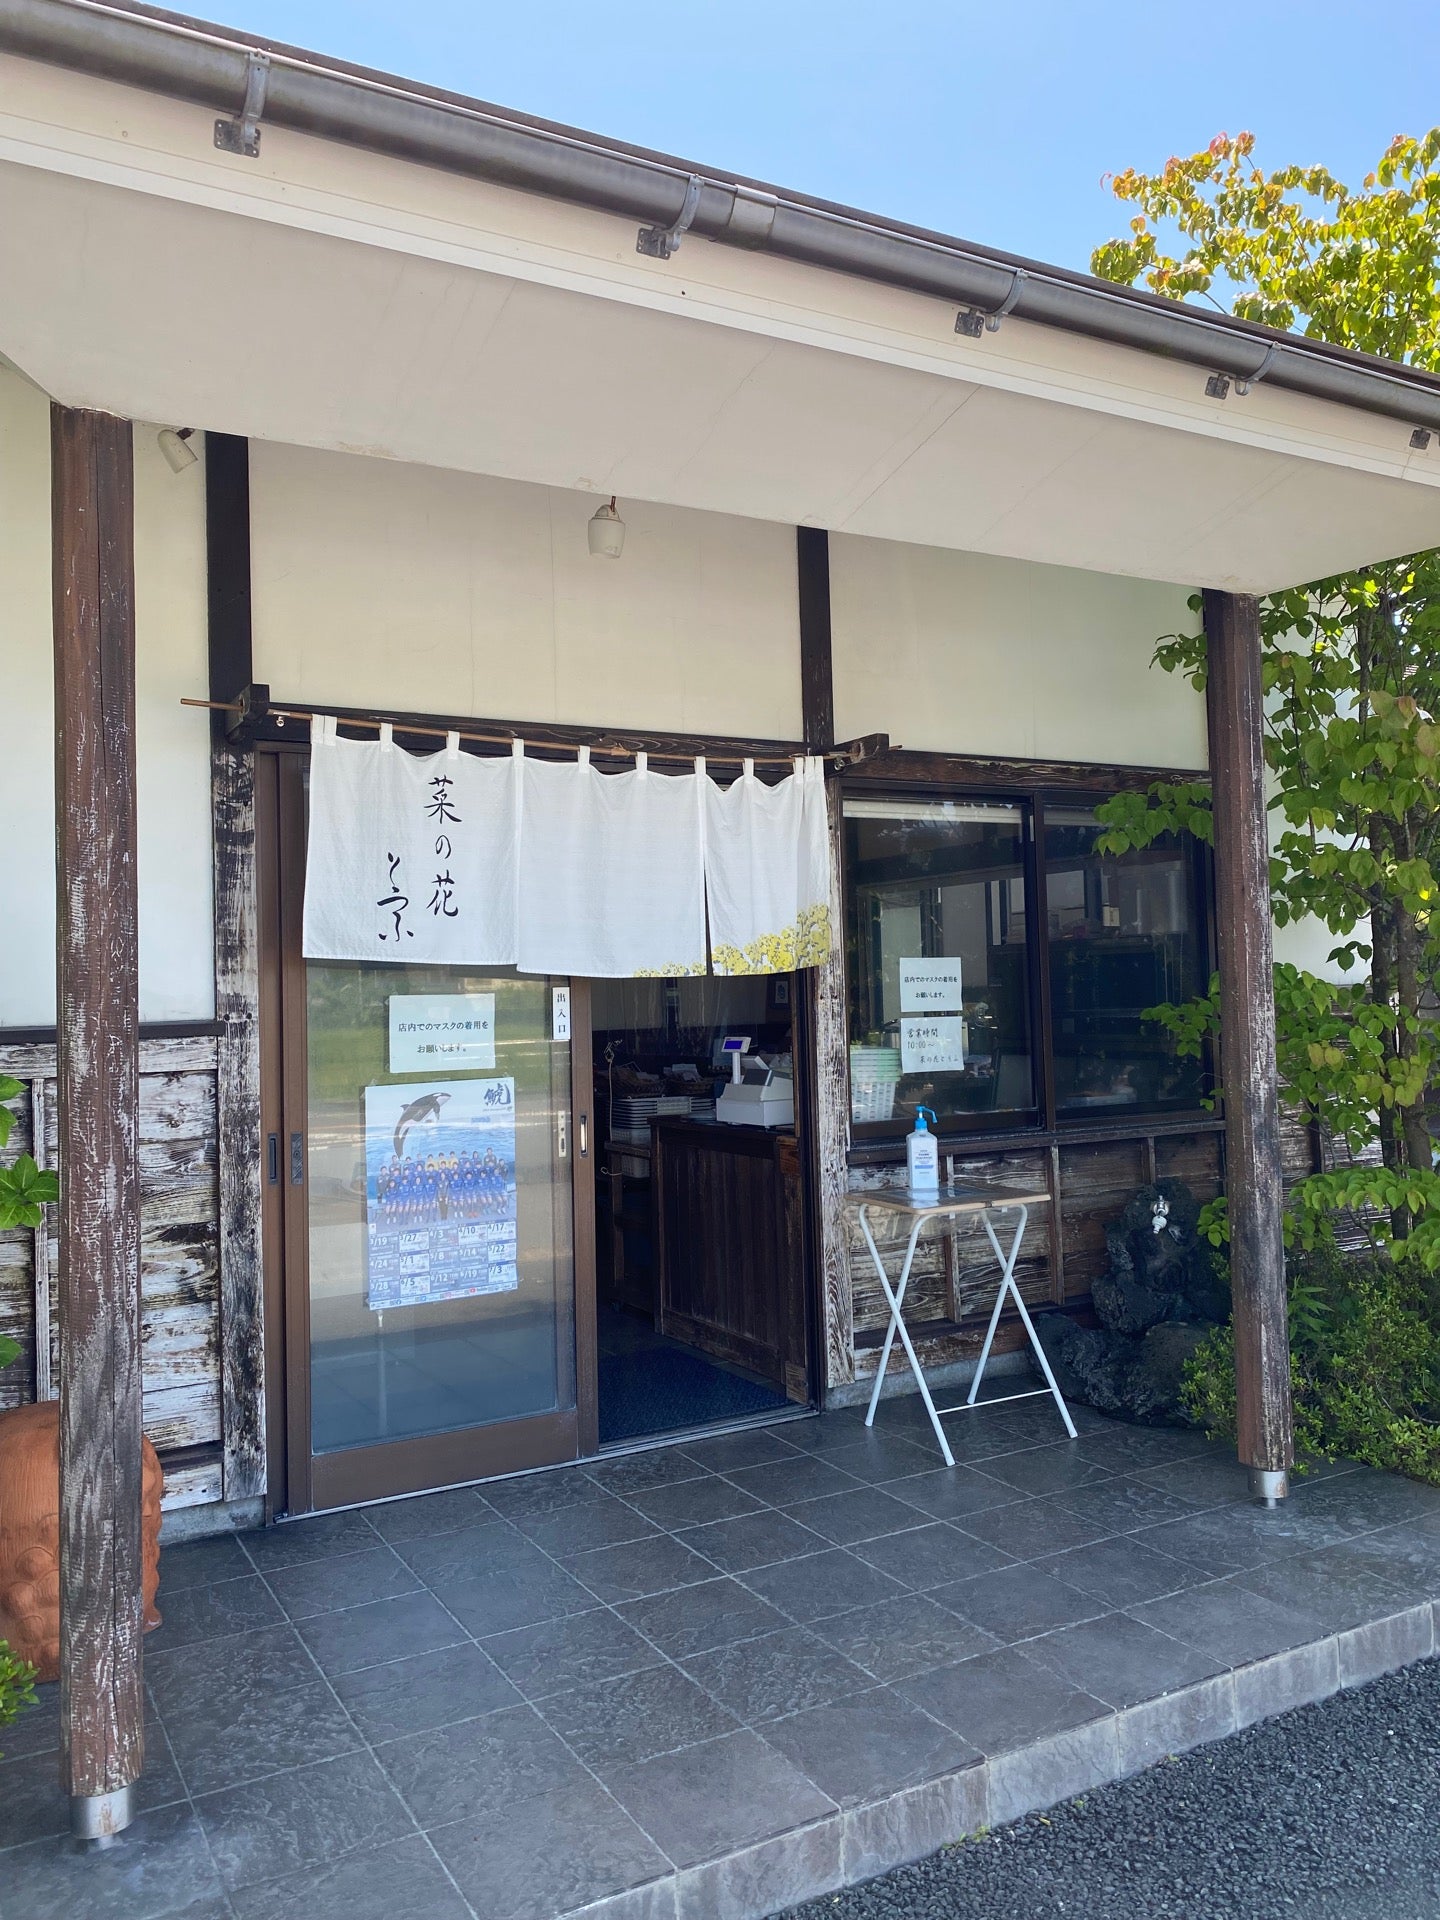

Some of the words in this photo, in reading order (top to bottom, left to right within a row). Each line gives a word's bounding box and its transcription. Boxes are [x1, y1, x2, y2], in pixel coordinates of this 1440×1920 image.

[424, 774, 462, 917] 菜の花
[377, 852, 414, 942] とうふ
[398, 1020, 489, 1032] 店内でのマスクの着用を
[556, 992, 567, 1034] 出入口
[907, 1027, 939, 1038] 営業時間
[416, 1042, 467, 1054] お願いします。
